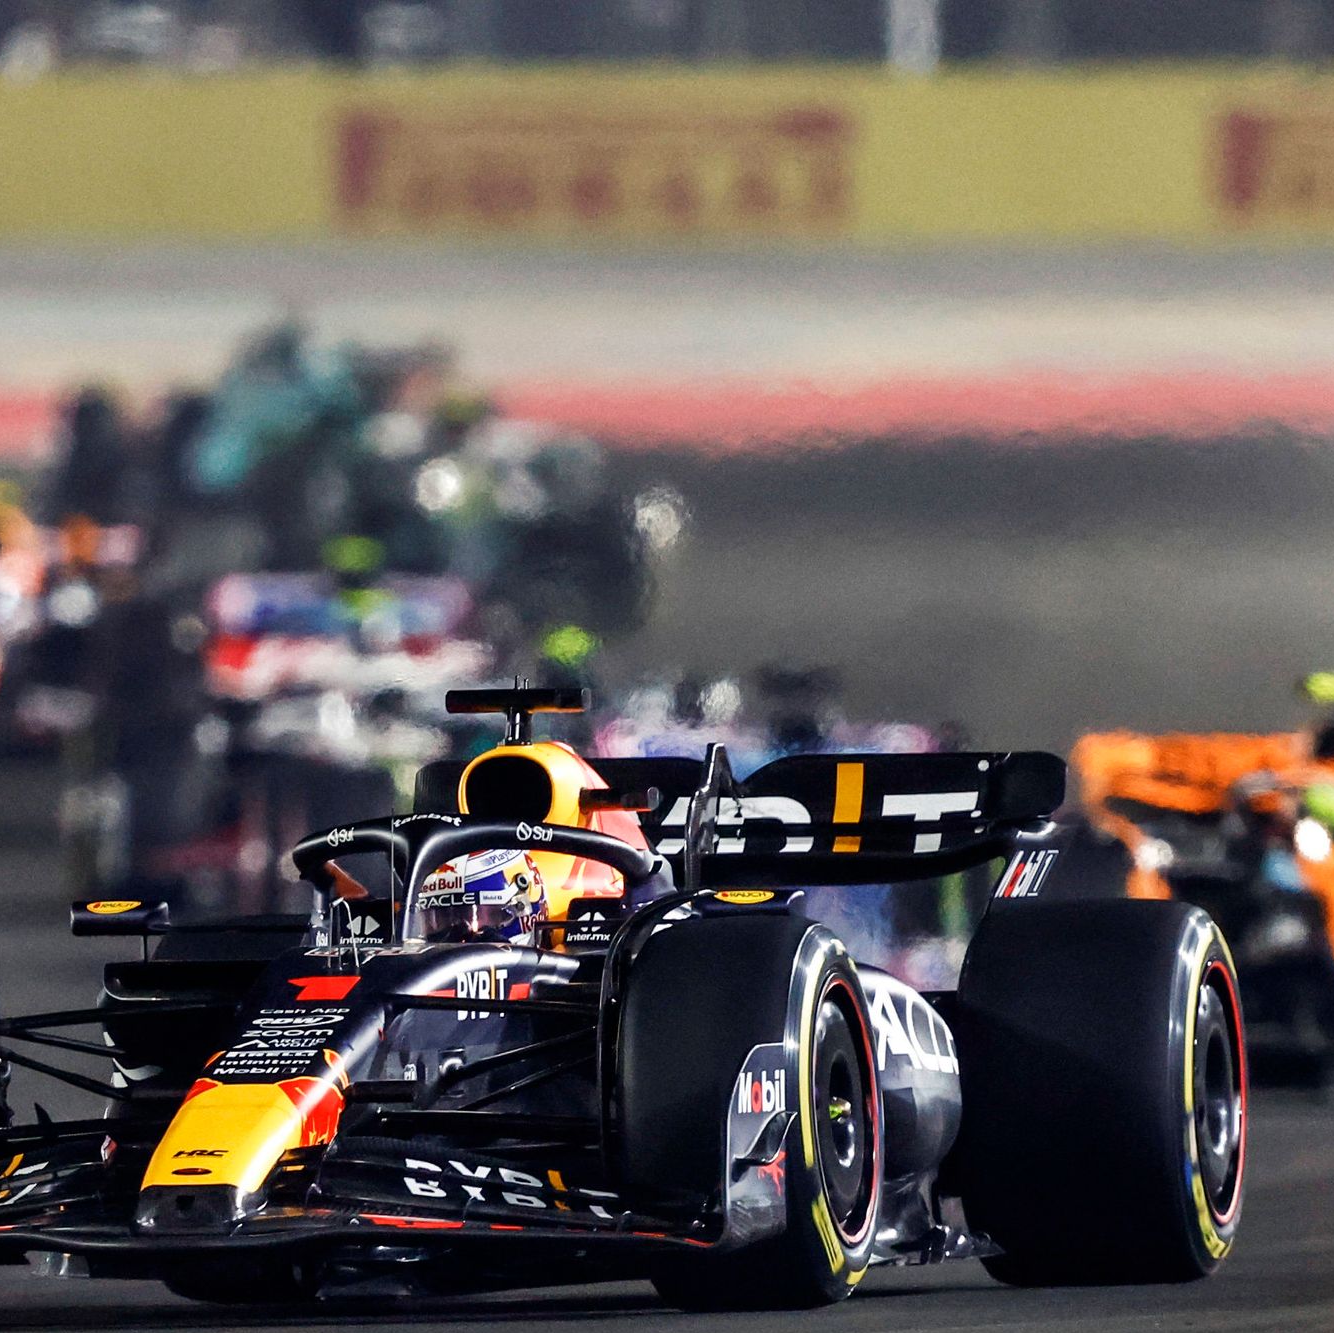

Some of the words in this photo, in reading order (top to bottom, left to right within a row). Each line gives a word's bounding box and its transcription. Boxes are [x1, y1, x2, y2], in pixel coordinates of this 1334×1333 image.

[393, 813, 462, 828] talabat
[532, 826, 553, 842] Sui
[438, 876, 463, 890] Bull
[417, 892, 476, 910] RACLE
[566, 931, 611, 942] inter.mx
[287, 976, 361, 1000] 1
[242, 1029, 334, 1037] zoom
[213, 1067, 280, 1075] Mobil
[738, 1069, 786, 1114] Mobil
[172, 1150, 229, 1159] HRC
